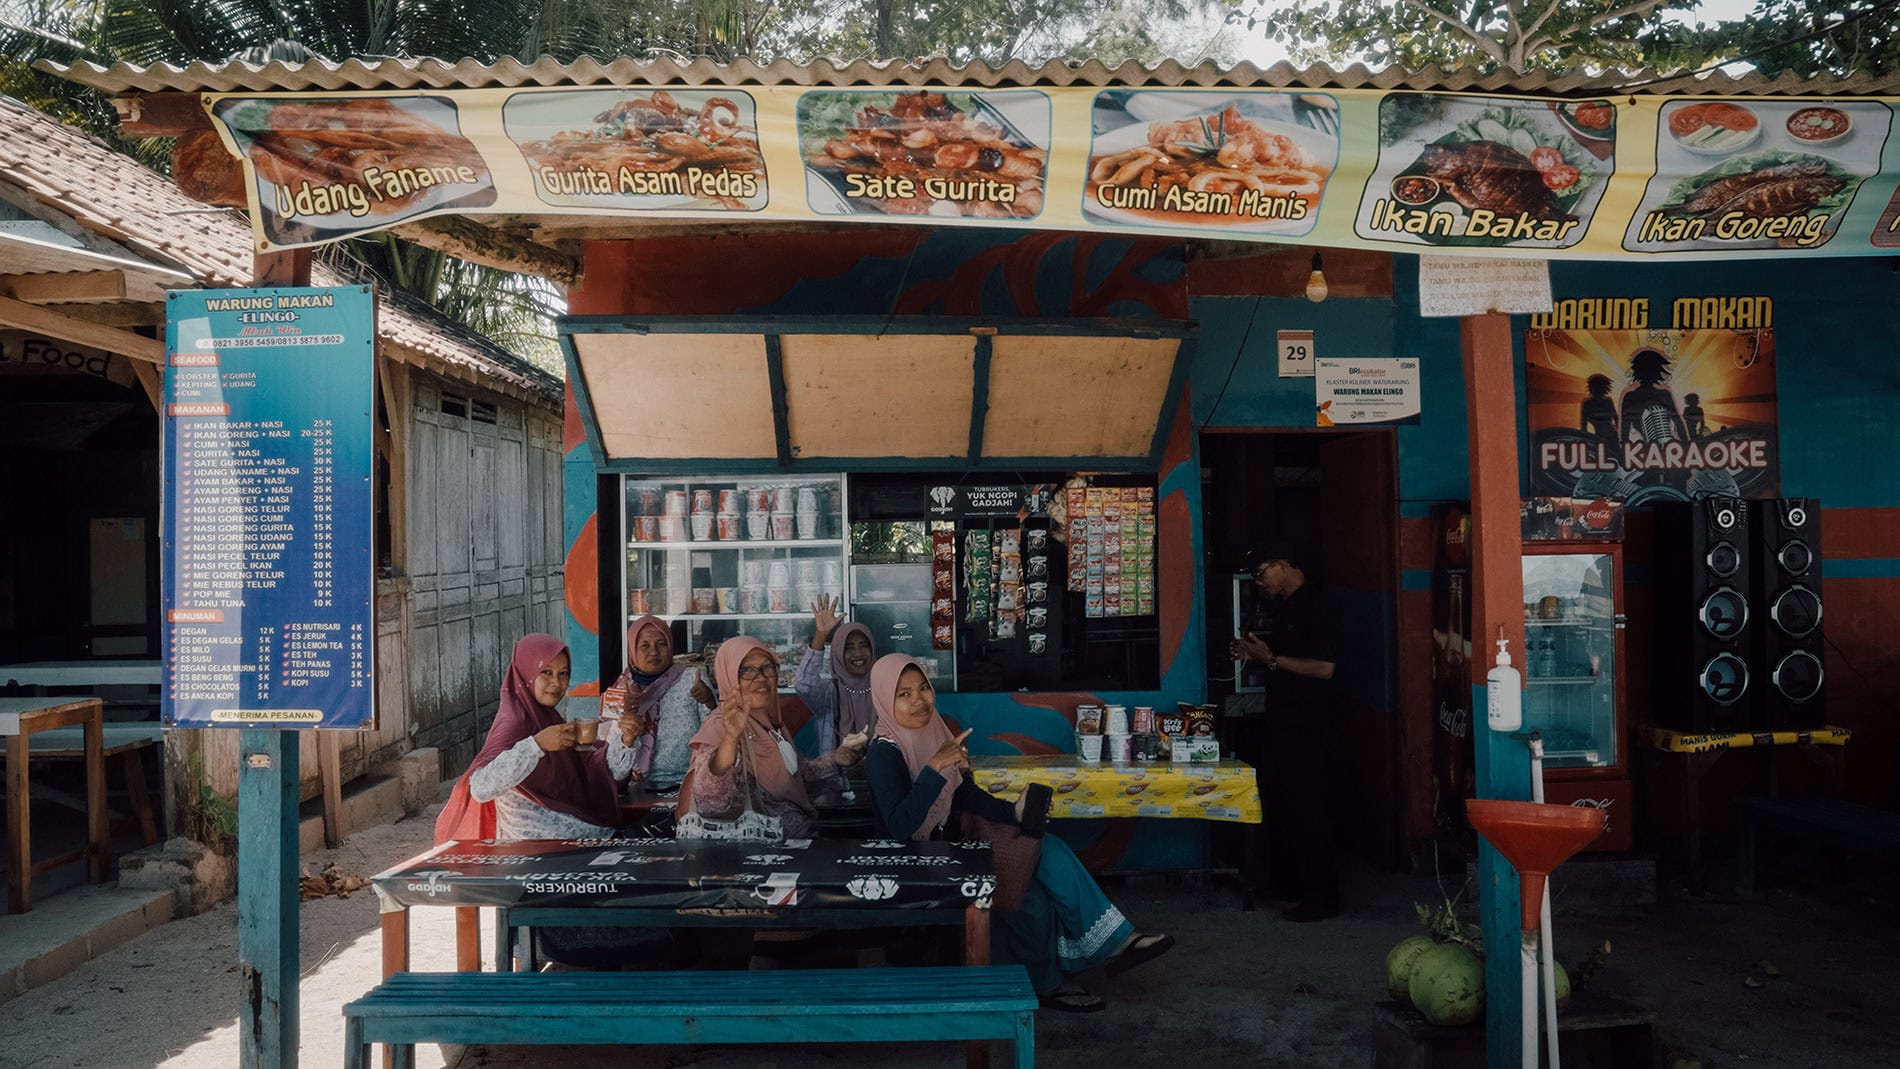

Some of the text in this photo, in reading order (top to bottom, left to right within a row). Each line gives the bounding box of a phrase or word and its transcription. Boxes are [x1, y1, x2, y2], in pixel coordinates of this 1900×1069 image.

[275, 166, 478, 217] Udang Faname
[540, 166, 757, 197] Gurita Asam Pedas
[846, 174, 1017, 202] Sate Gurita
[1097, 183, 1308, 219] Cumi Asam Manis
[1370, 199, 1580, 241] Ikan Bakar
[1637, 210, 1829, 246] Ikan Goreng
[206, 295, 333, 311] WARUNG MAKAN
[1673, 297, 1772, 329] MAKAN
[235, 339, 254, 347] 3956
[1287, 346, 1306, 360] 29
[23, 339, 112, 379] Food
[174, 356, 216, 364] SEAFOOD
[174, 405, 224, 413] MAKANAN
[1541, 441, 1767, 470] FULL KARAOKE
[522, 882, 619, 895] TUBRUKERS,
